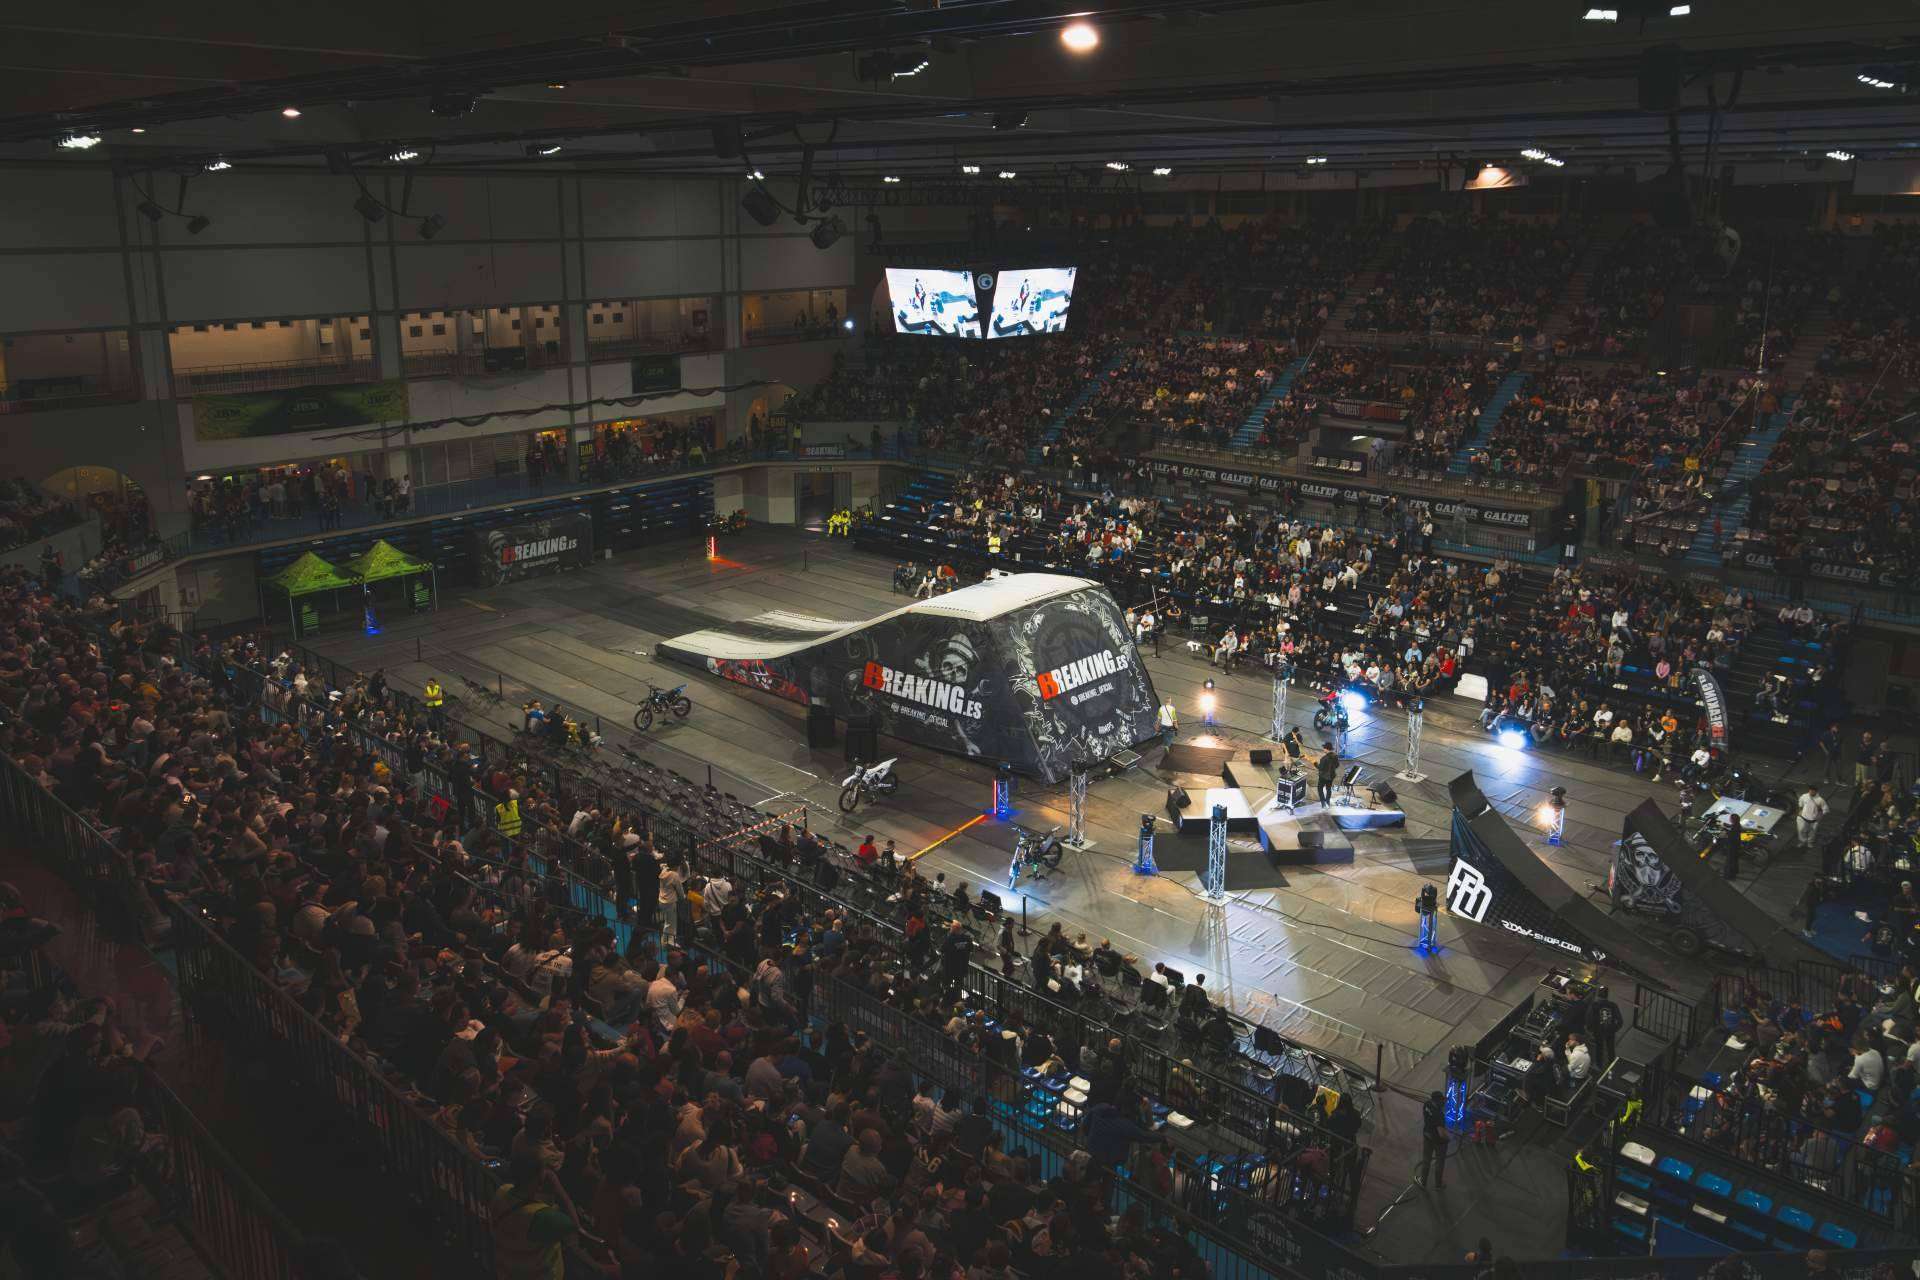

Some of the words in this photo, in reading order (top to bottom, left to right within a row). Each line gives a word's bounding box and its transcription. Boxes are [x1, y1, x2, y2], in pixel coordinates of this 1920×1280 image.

[580, 443, 594, 457] BAR
[1483, 510, 1530, 525] GALFER
[1810, 562, 1871, 583] GALFER
[1035, 649, 1129, 703] BREAKING.ES
[863, 659, 983, 720] BREAKING.ES
